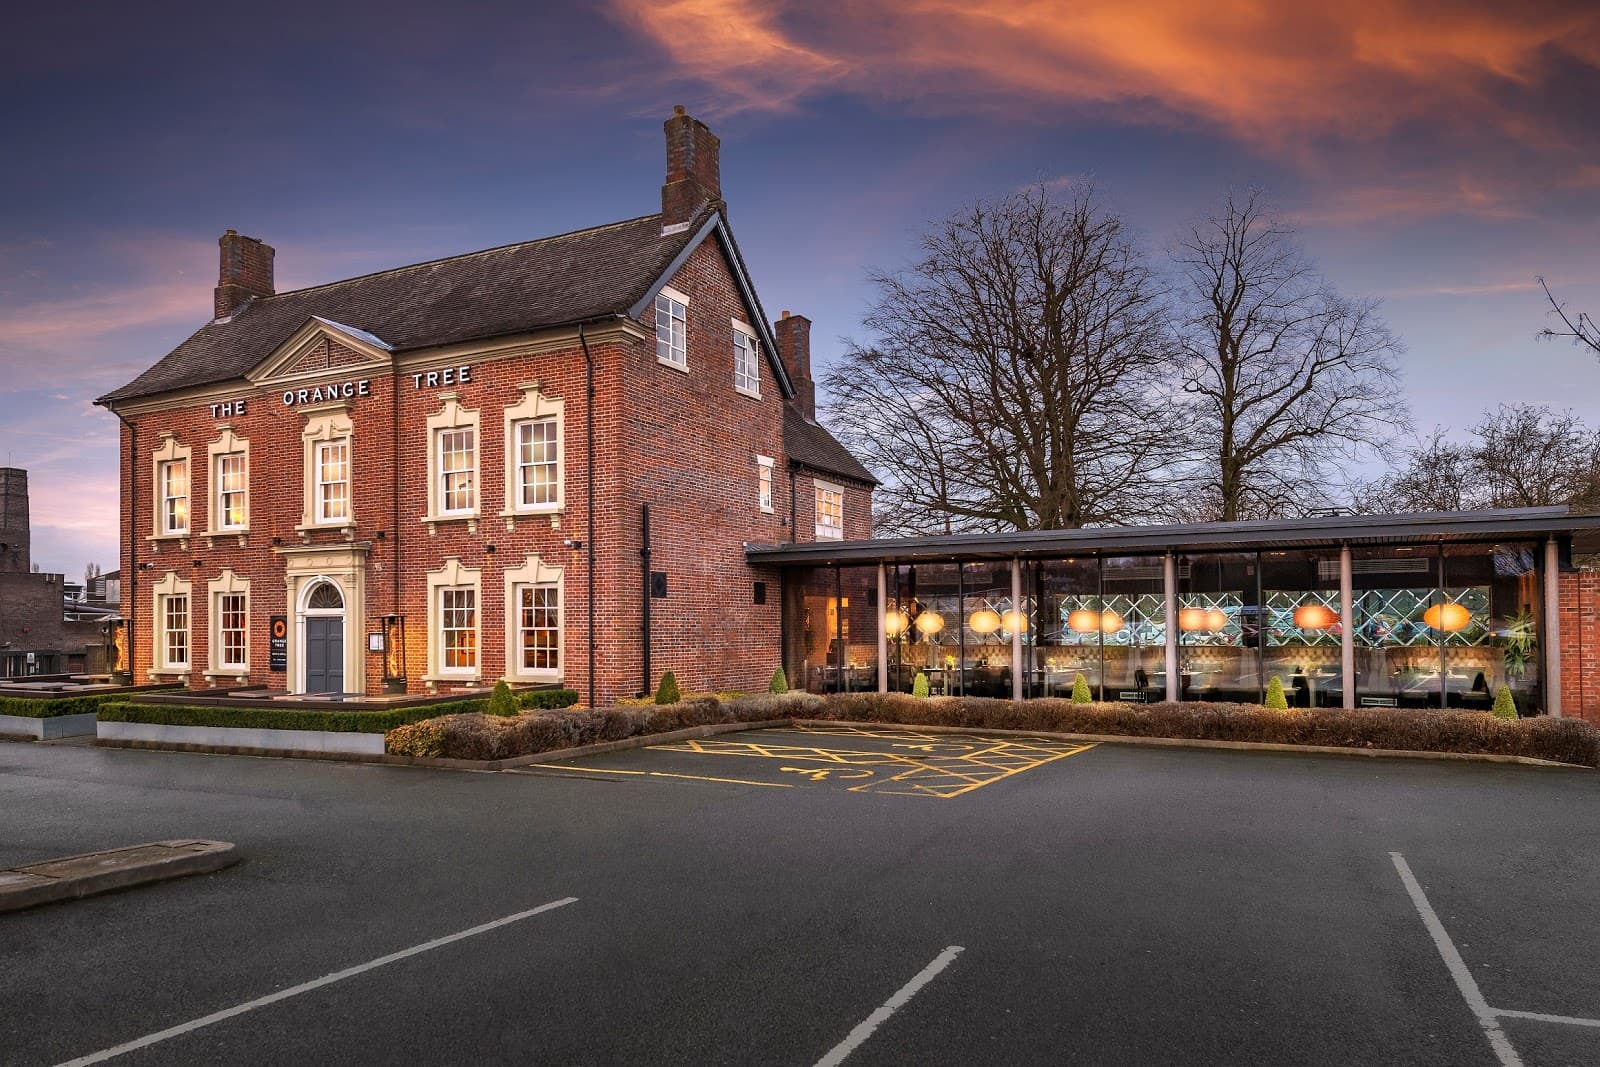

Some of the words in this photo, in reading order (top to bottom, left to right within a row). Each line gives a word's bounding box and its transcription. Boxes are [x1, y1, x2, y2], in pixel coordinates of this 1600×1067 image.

[210, 401, 244, 418] THE
[283, 380, 369, 405] ORANGE
[412, 366, 470, 389] TREE
